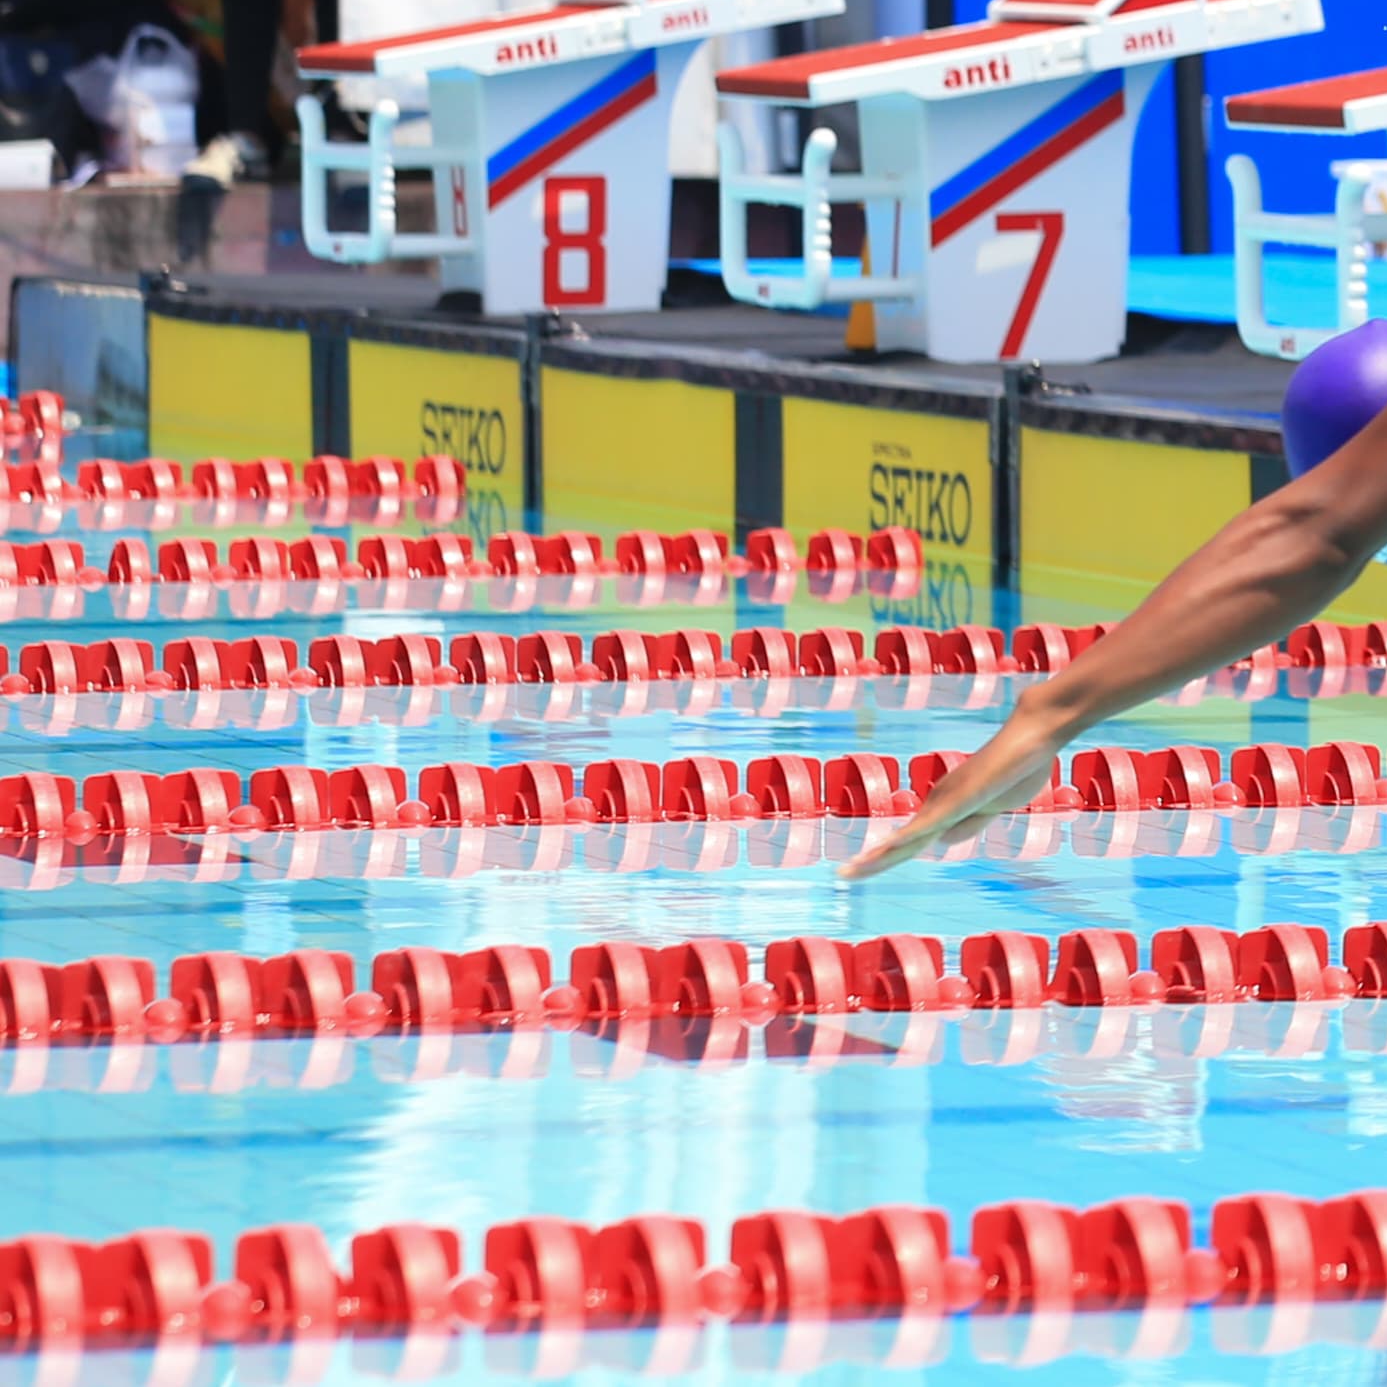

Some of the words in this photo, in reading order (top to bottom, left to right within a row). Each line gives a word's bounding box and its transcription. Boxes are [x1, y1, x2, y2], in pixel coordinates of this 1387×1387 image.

[661, 6, 709, 32] anti
[1123, 27, 1175, 53] anti
[496, 35, 558, 64] anti
[943, 56, 1012, 89] anti
[542, 174, 607, 307] 8
[995, 212, 1064, 359] 7
[421, 400, 506, 475] SEIKO
[870, 462, 972, 547] SEIKO
